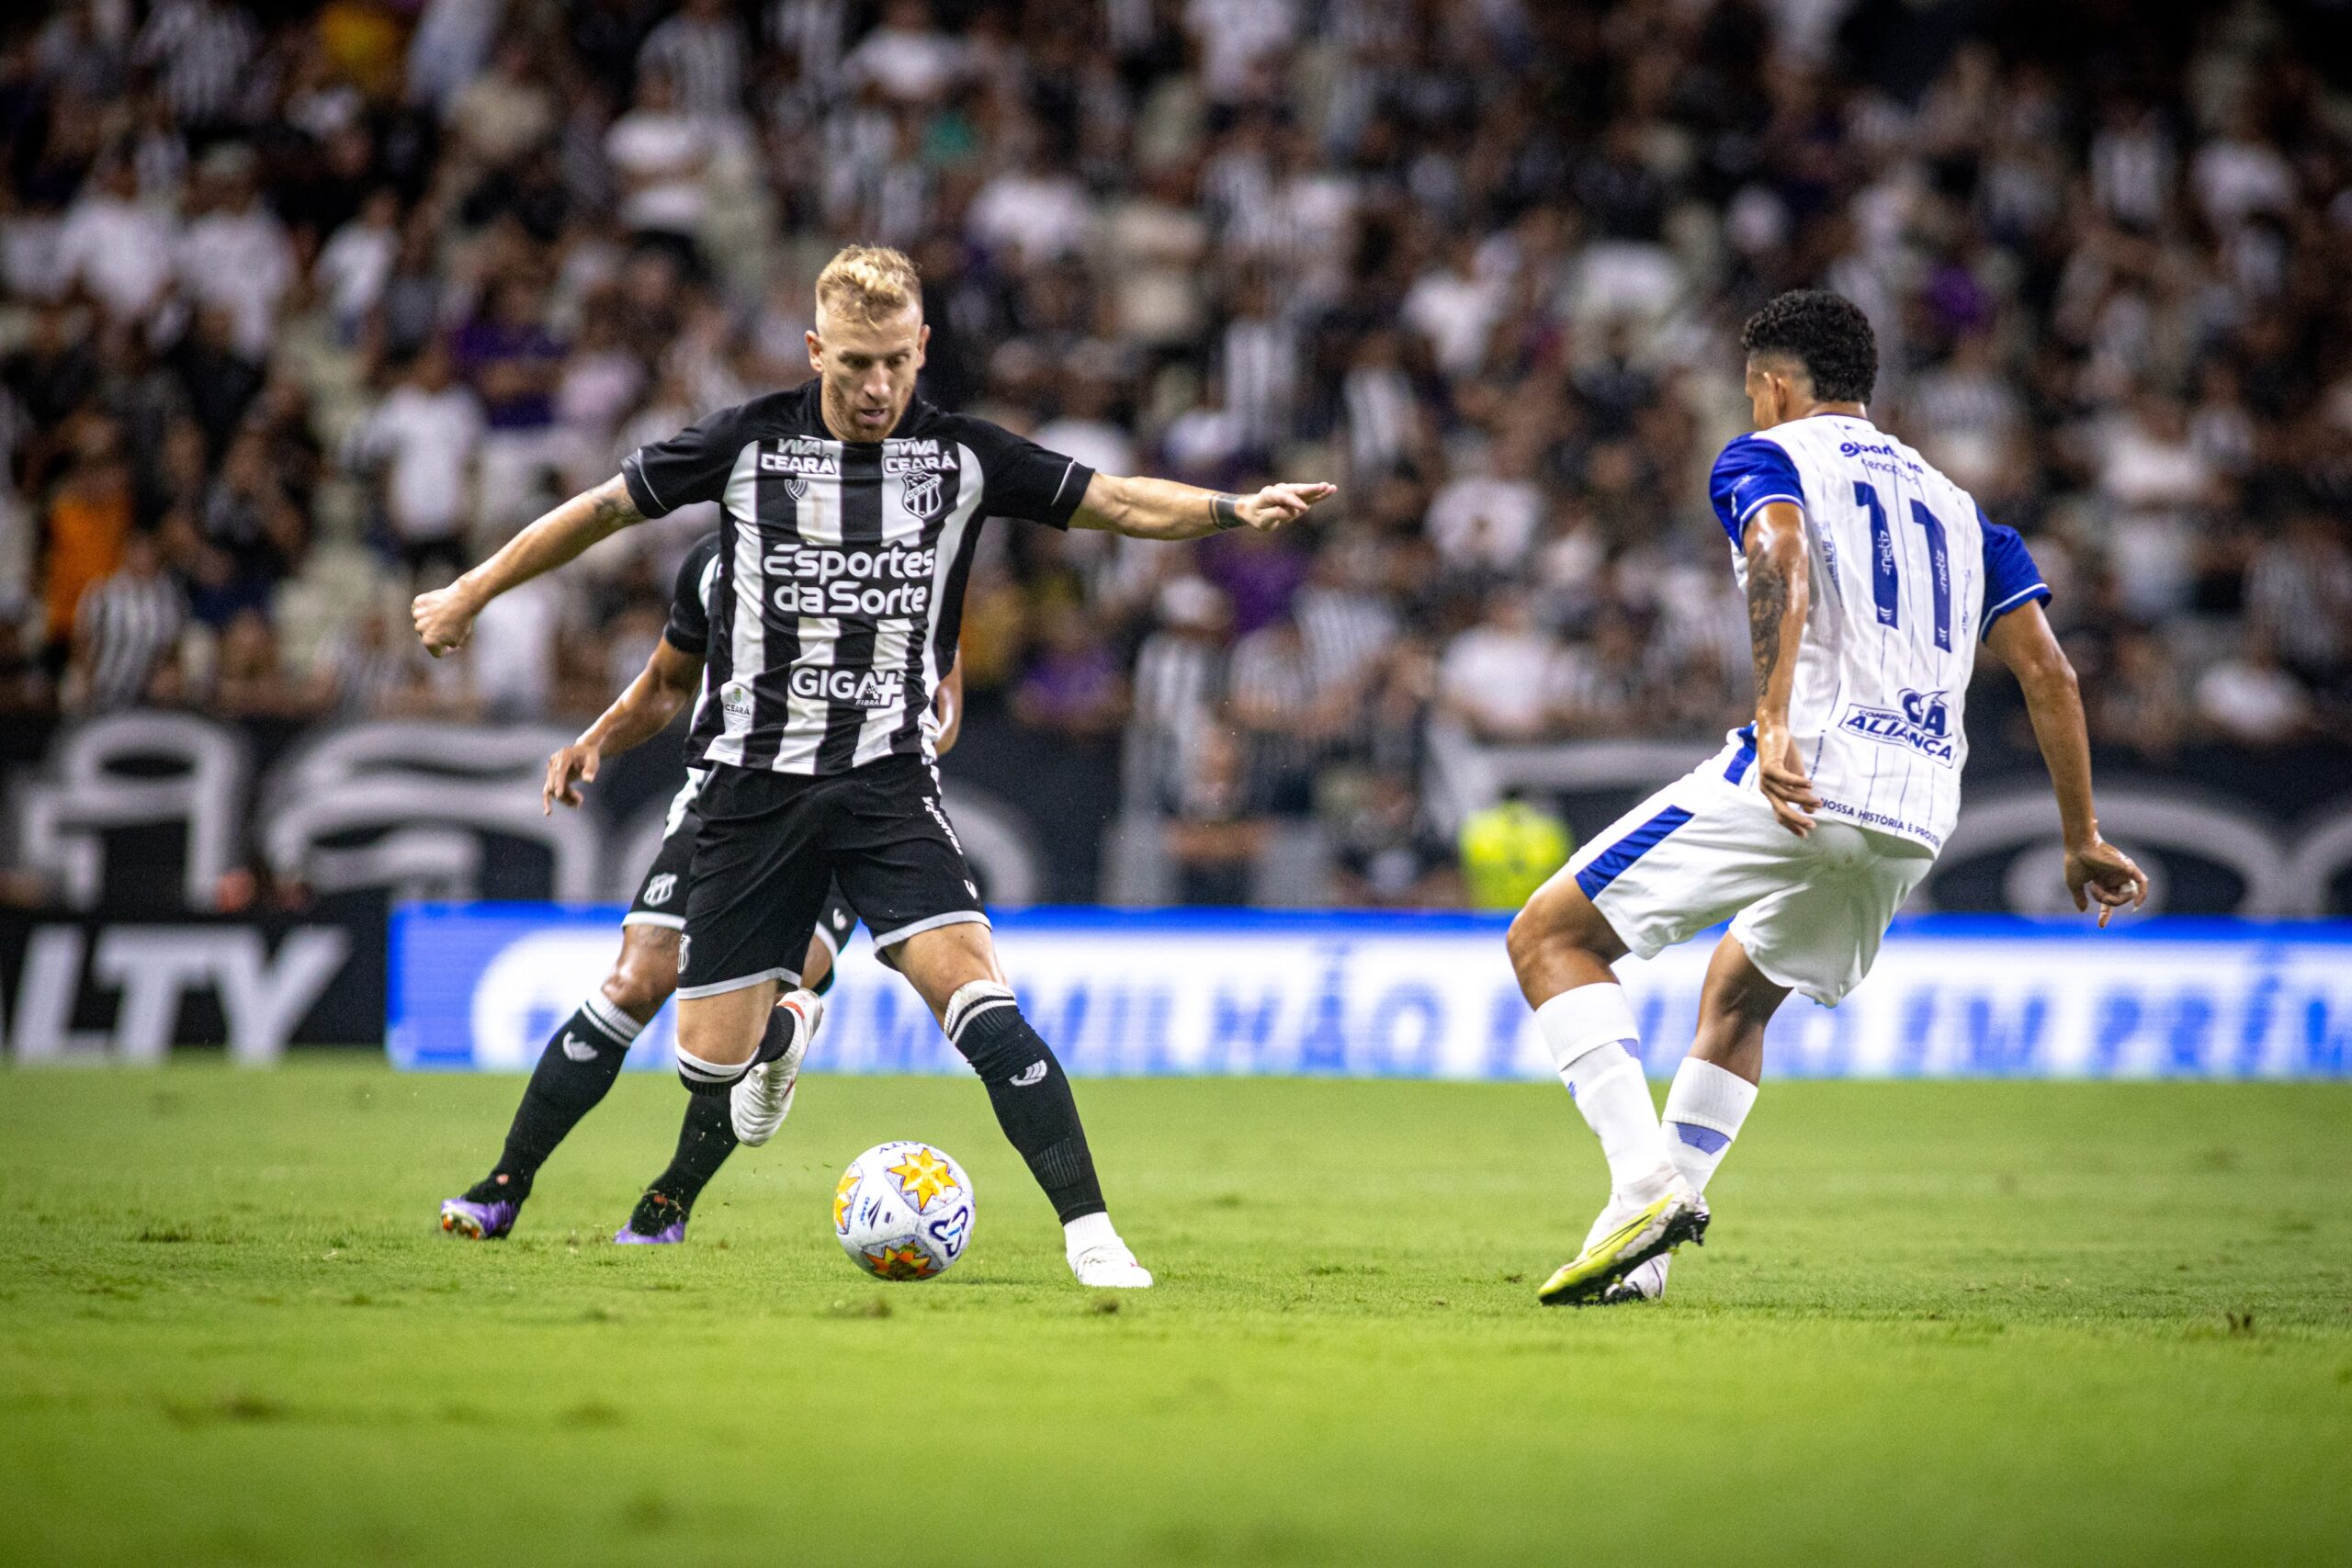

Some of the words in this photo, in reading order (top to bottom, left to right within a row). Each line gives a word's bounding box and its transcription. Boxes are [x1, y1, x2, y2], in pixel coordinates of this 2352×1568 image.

[777, 438, 822, 455] VIVA
[885, 451, 958, 472] CEARÁ
[899, 439, 939, 455] VIVA
[763, 544, 935, 585] Esportes
[1852, 481, 1951, 653] 11
[725, 704, 750, 716] CEARÁ
[1847, 716, 1951, 761] ALIANÇA
[1820, 797, 1855, 817] NOSSA
[1858, 809, 1905, 830] HISTÓRIA
[0, 922, 354, 1070] LTY
